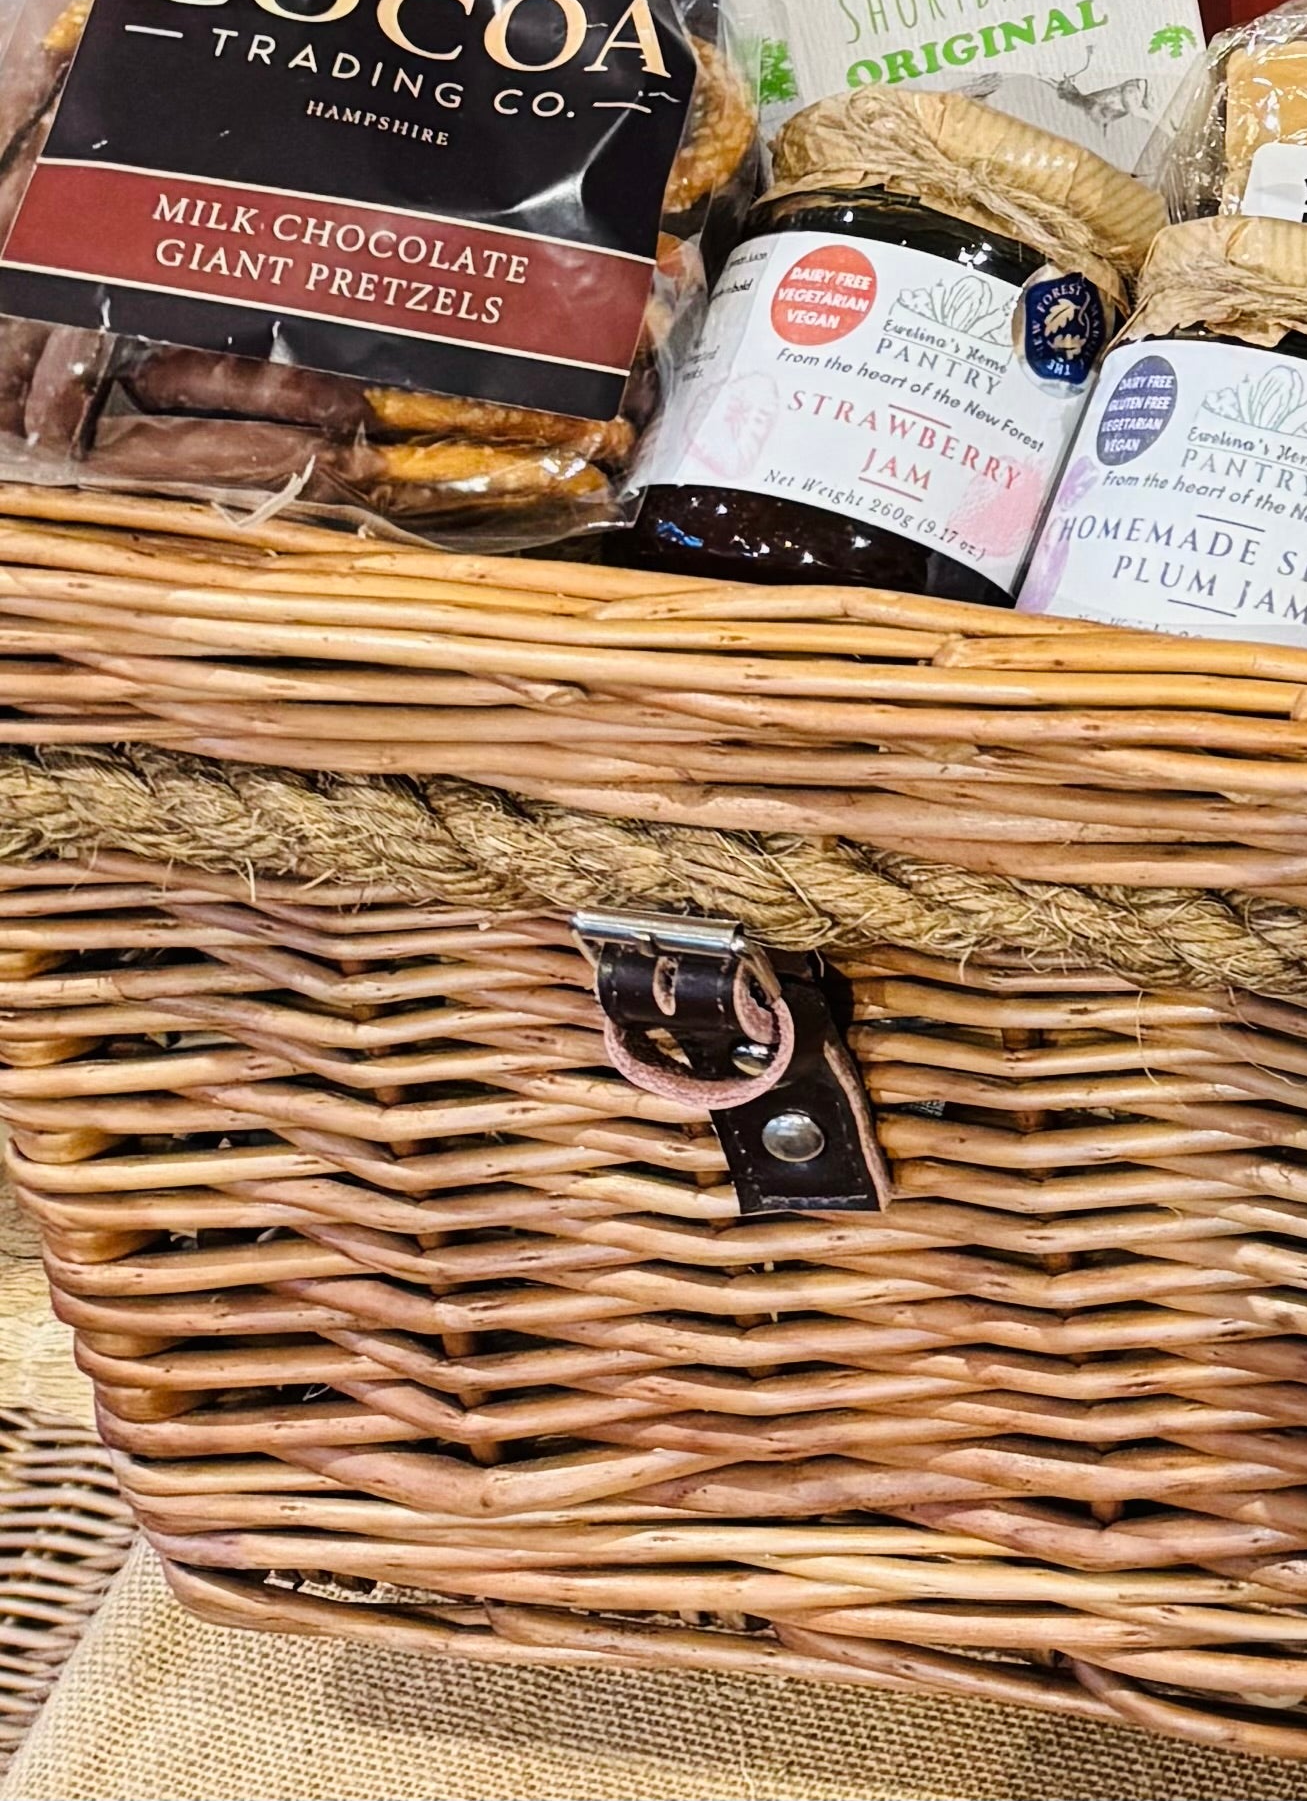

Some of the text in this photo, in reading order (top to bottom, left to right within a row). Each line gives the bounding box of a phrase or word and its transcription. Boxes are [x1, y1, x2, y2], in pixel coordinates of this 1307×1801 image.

[846, 0, 1109, 89] ORIGINAL
[211, 26, 576, 119] TRADING CO.
[304, 99, 451, 147] HAMPSHIRE
[152, 192, 531, 286] MILK CHOCOLATE
[154, 237, 505, 326] GIANT PRETZELS
[777, 288, 871, 313] VEGETARIAN
[786, 310, 841, 330] VEGAN
[787, 390, 1023, 491] STRAWBERRY
[860, 447, 933, 491] JAM
[1059, 515, 1263, 566] HOMEMADE
[1112, 554, 1217, 598] PLUM
